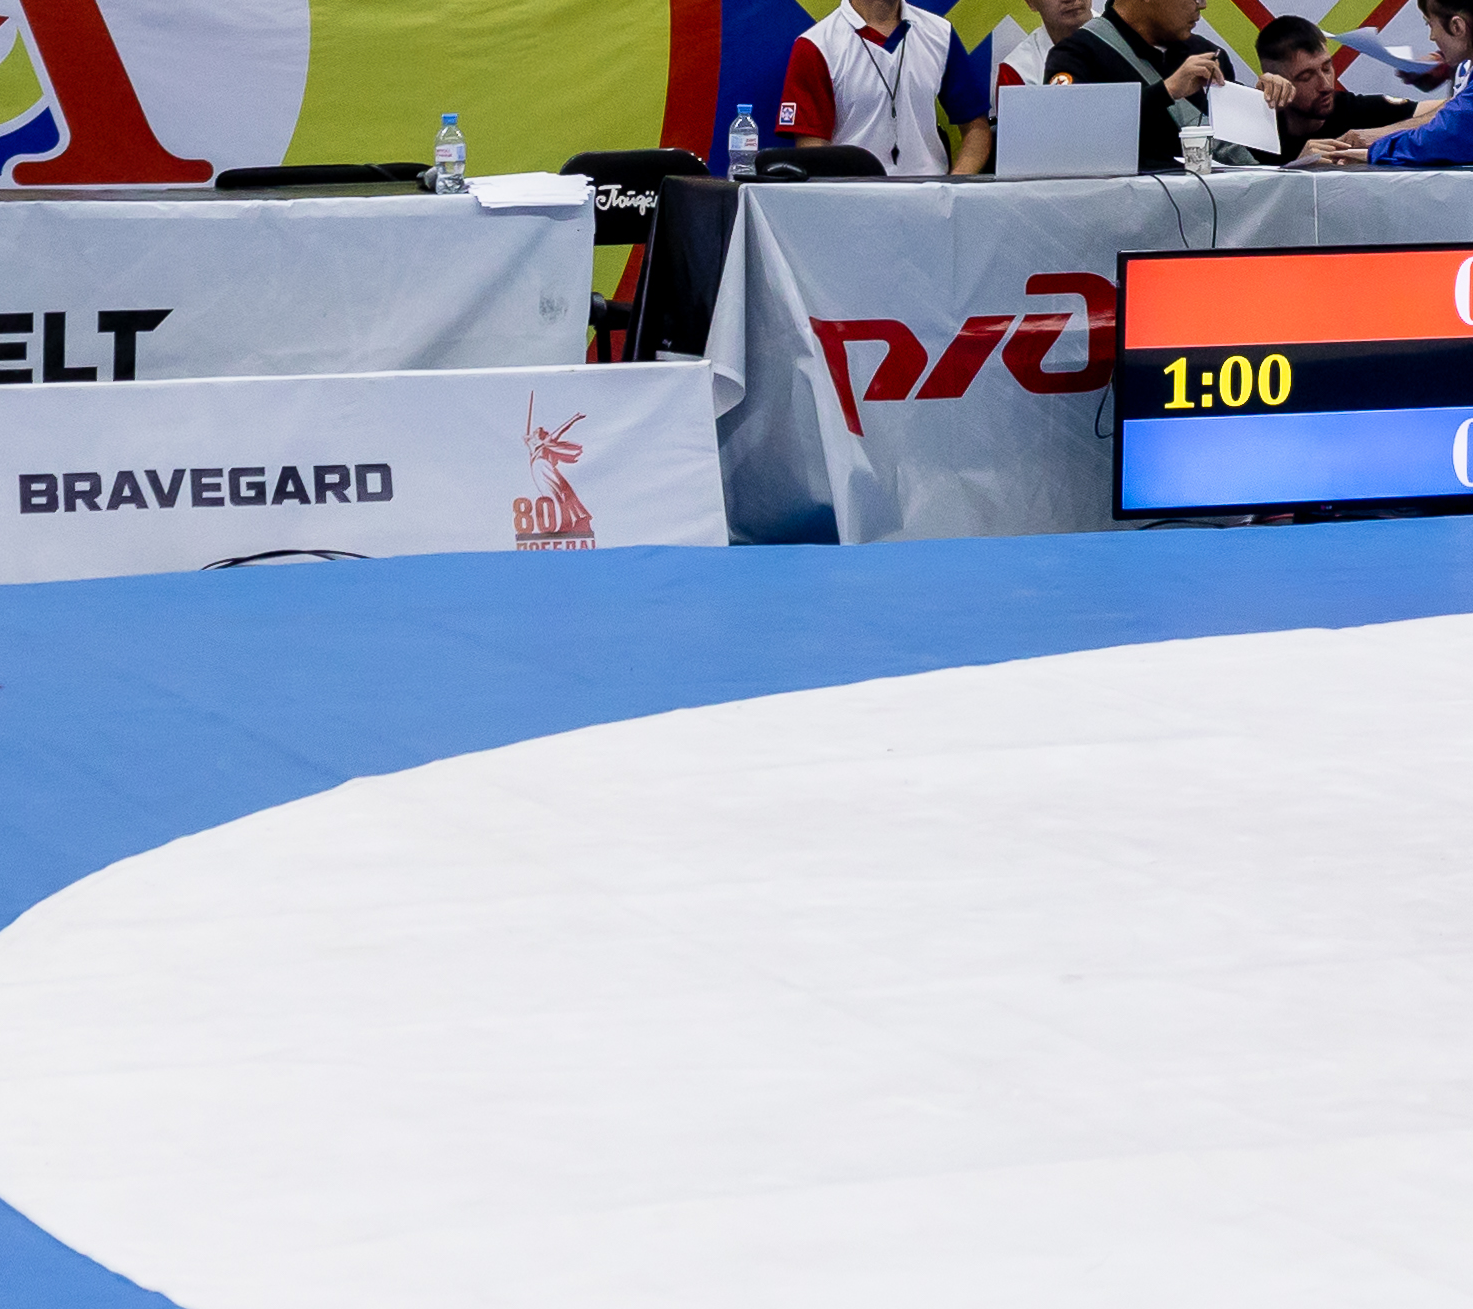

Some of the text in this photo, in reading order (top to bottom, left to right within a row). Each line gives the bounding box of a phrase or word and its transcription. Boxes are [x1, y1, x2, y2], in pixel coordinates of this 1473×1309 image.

[1163, 353, 1293, 410] 1:00
[18, 462, 394, 515] BRAVEGARD
[513, 496, 557, 534] 80
